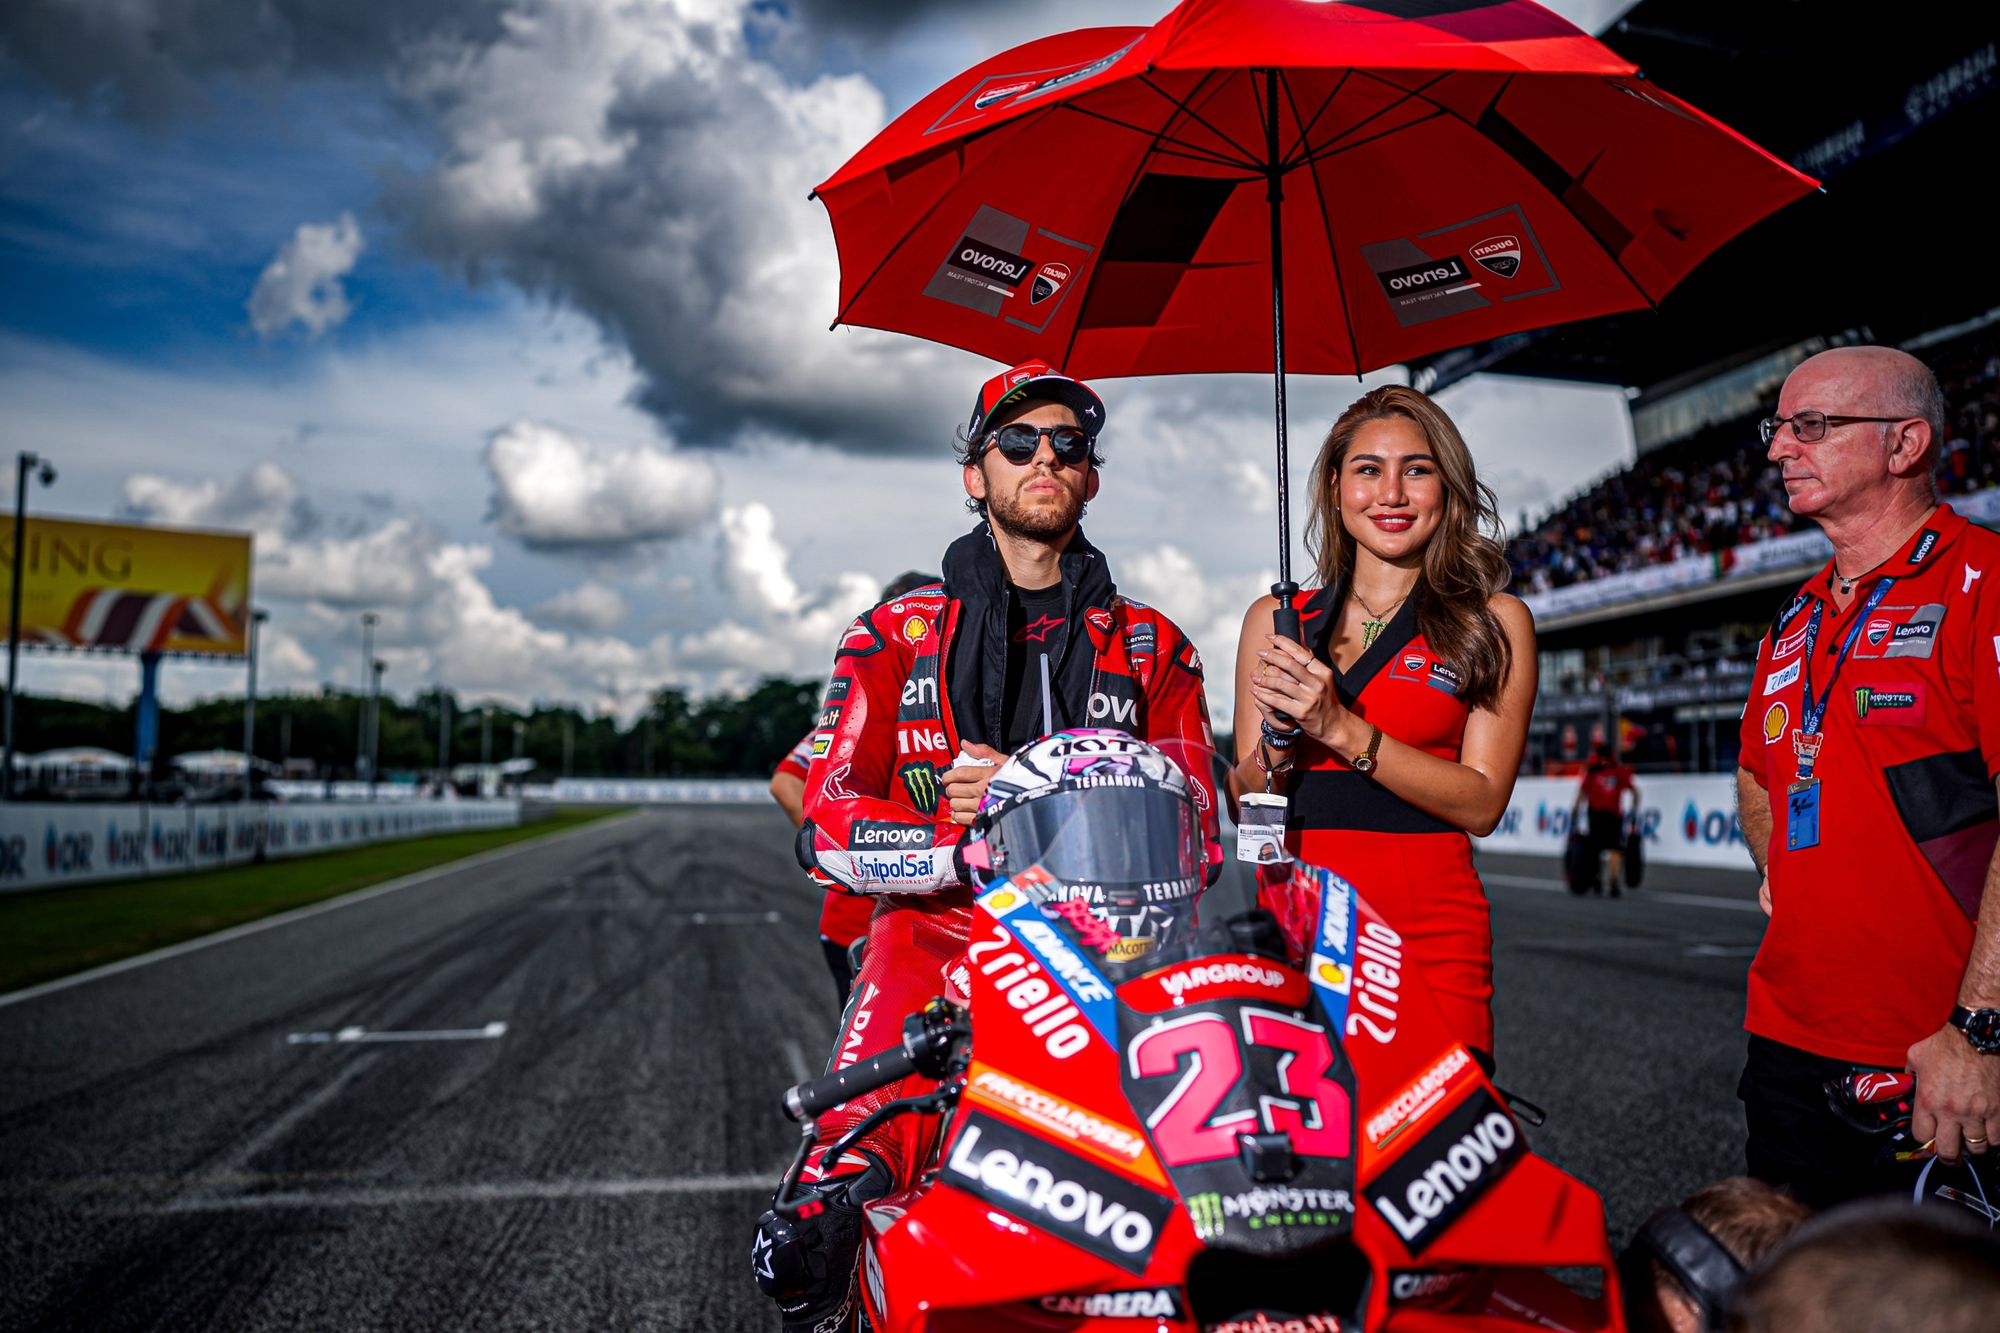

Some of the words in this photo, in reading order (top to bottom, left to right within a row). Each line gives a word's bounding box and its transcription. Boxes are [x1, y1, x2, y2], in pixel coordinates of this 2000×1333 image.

[1911, 534, 1935, 563] Lenovo
[1126, 635, 1154, 644] Lenovo
[1895, 625, 1930, 636] Lenovo
[1433, 664, 1458, 680] Leno
[1870, 693, 1913, 703] MONSTER
[1075, 775, 1146, 790] TERRANOVA
[854, 826, 926, 844] Lenovo
[851, 854, 934, 883] UnipolSai
[1130, 1006, 1352, 1168] 23
[948, 1124, 1154, 1254] Lenovo
[1375, 1111, 1516, 1242] Lenovo
[1222, 1184, 1356, 1218] MONSTER
[1041, 1288, 1176, 1318] CARRERA
